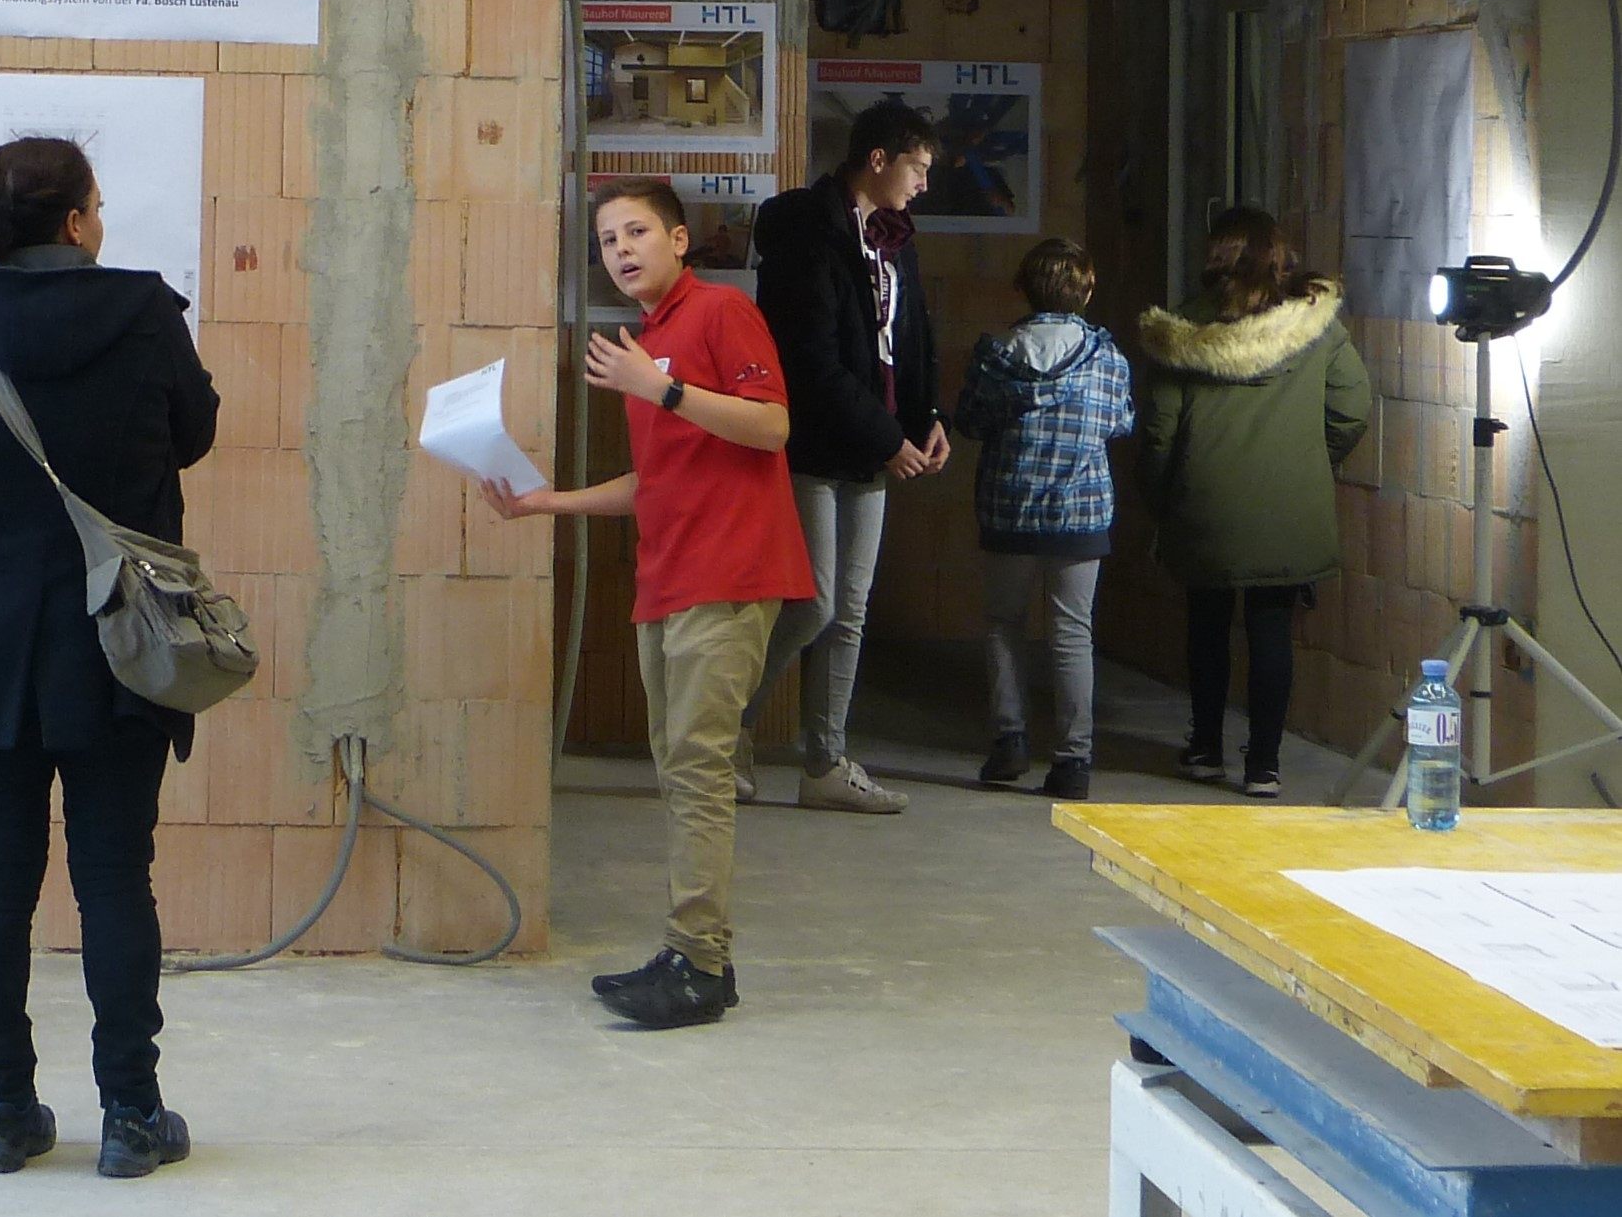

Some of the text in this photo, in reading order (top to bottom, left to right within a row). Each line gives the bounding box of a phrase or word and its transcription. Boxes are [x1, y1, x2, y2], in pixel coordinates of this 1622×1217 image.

[702, 5, 755, 24] HTL
[956, 64, 1019, 86] HTL
[701, 176, 755, 194] HTL
